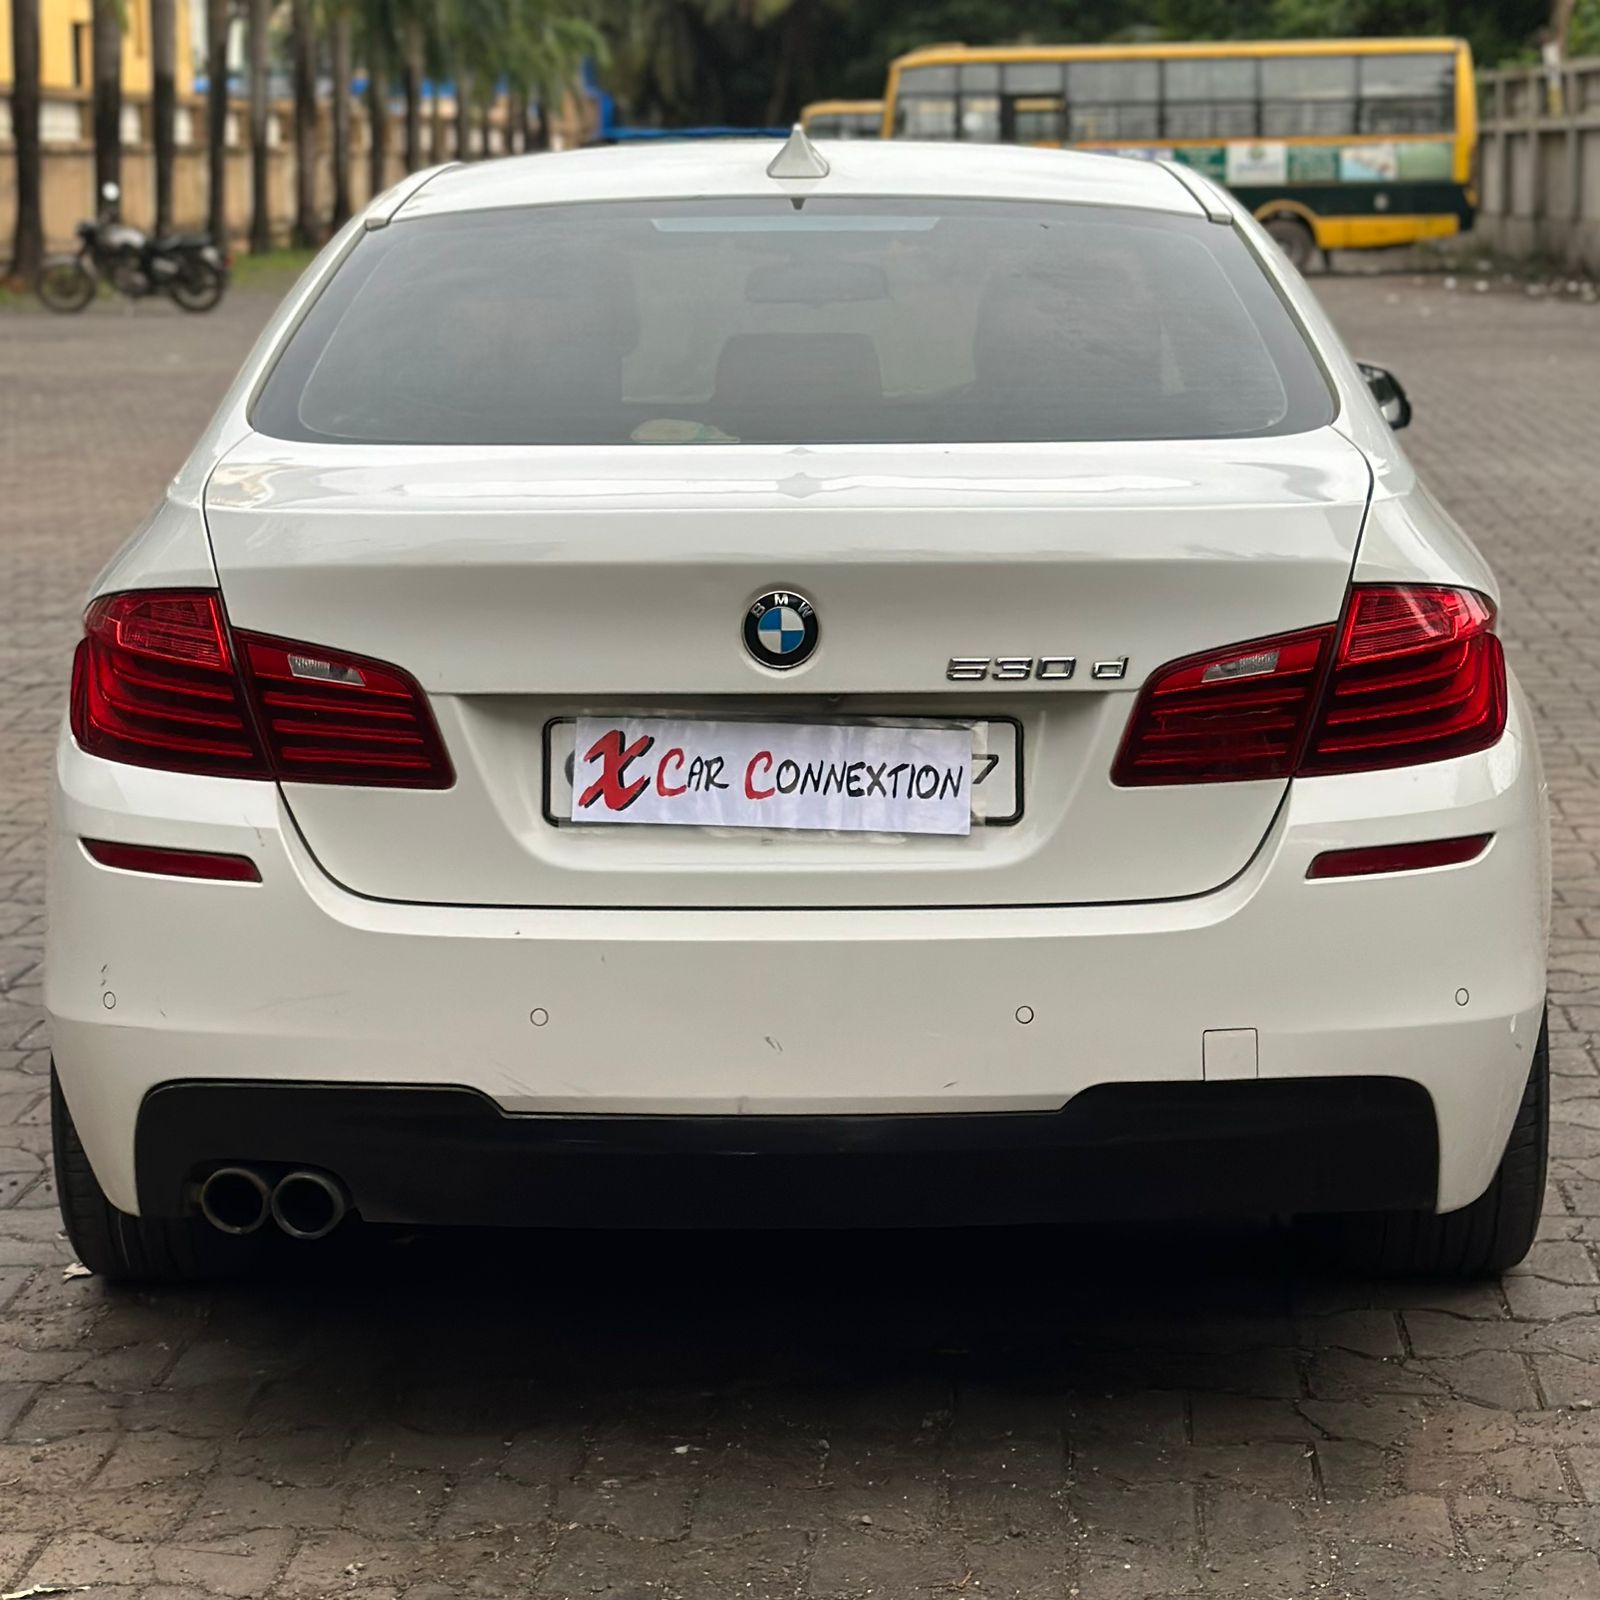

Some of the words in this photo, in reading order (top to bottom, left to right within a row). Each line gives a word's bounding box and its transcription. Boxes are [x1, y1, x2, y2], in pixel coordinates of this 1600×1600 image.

[751, 593, 813, 618] BMW
[946, 656, 1077, 681] 530
[1091, 656, 1130, 680] d
[578, 729, 655, 811] X
[656, 747, 730, 797] CAR
[744, 750, 964, 800] CONNEXTION
